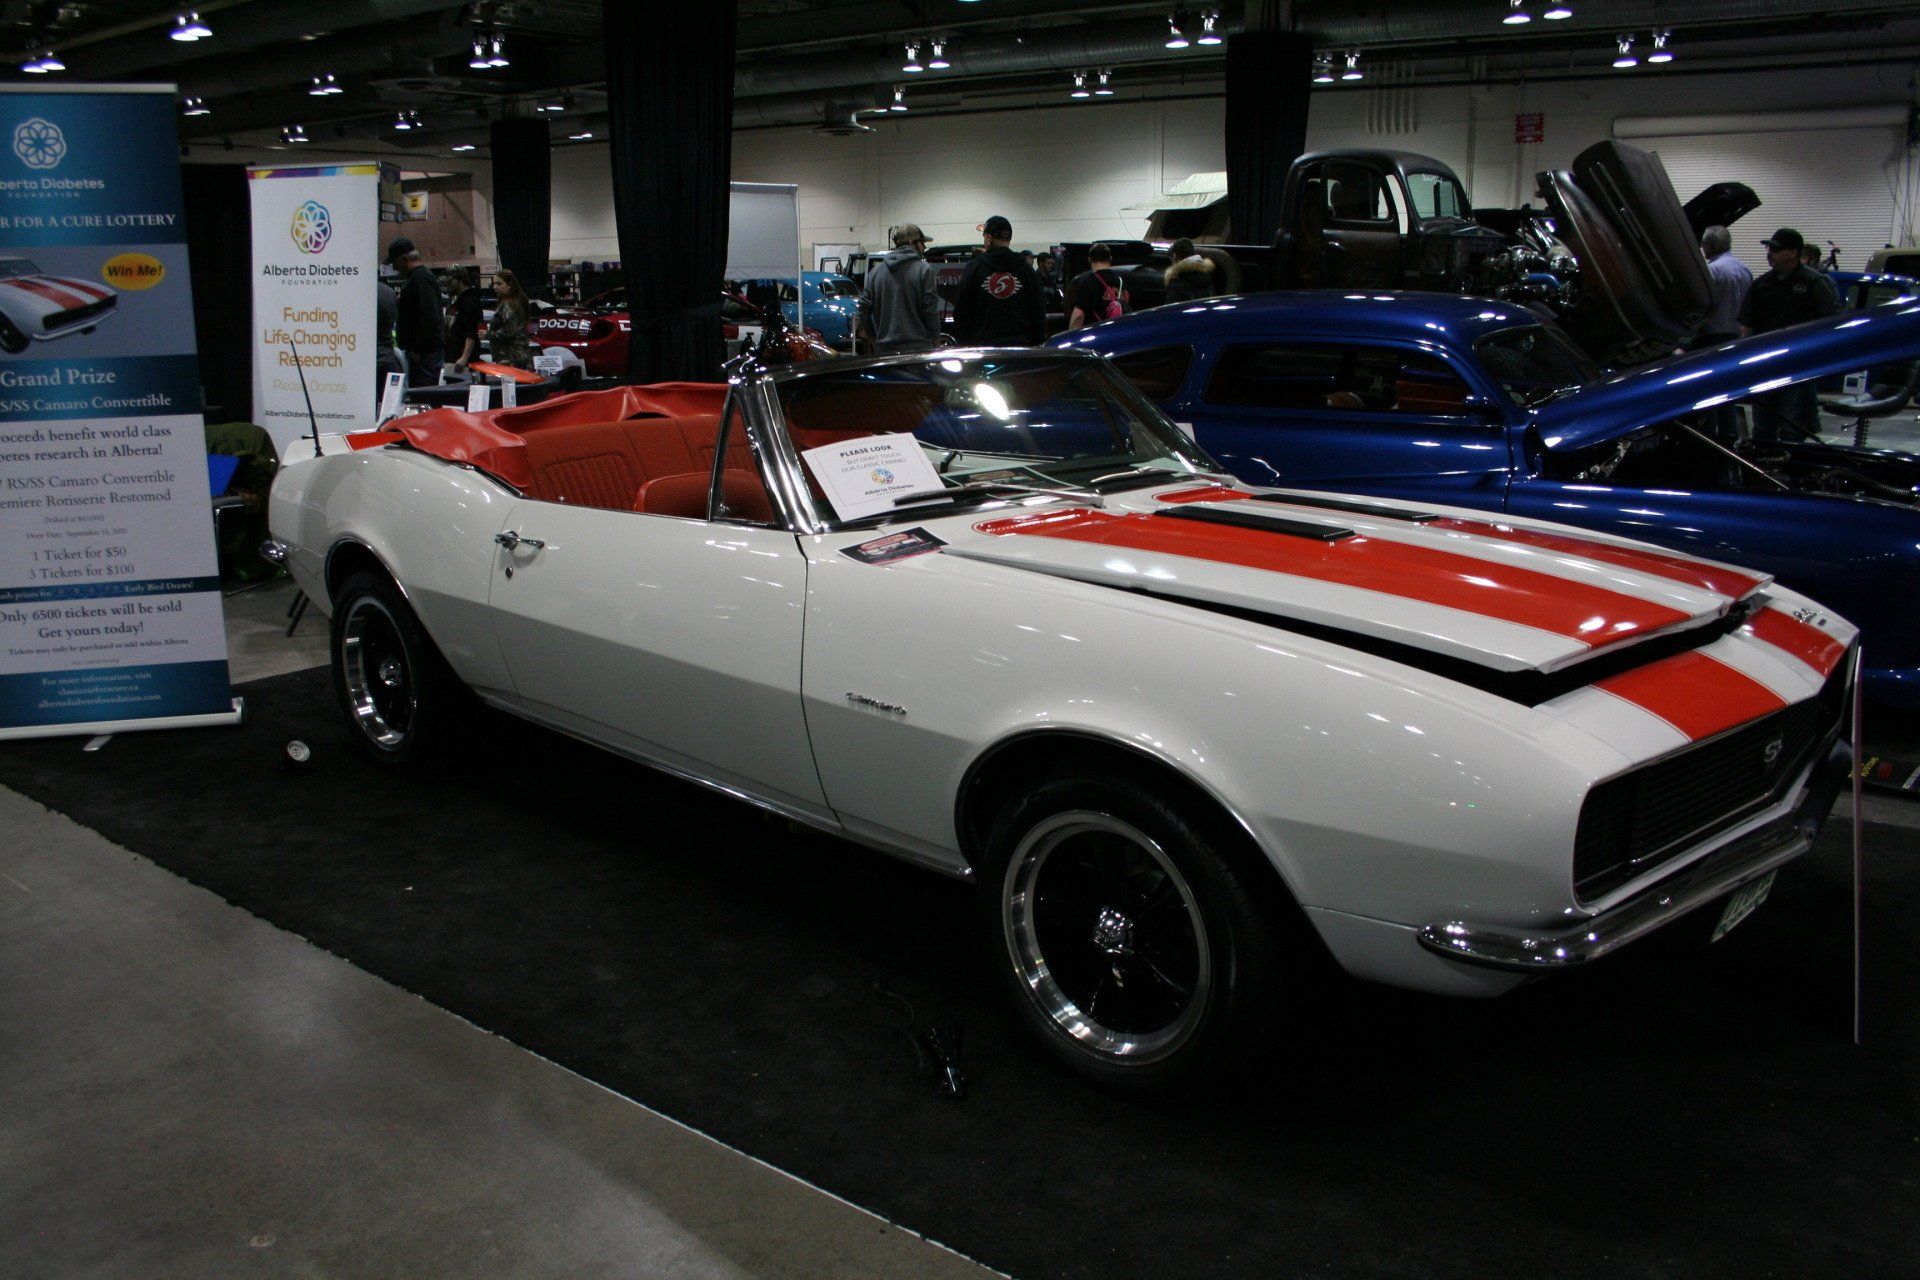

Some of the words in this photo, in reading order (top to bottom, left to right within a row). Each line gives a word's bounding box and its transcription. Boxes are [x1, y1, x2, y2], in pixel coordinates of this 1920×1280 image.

[42, 178, 105, 190] Diabetes
[14, 217, 45, 229] FOR
[49, 217, 59, 228] A
[63, 215, 103, 227] CURE
[106, 213, 176, 226] LOTTERY
[108, 265, 133, 277] Win
[137, 264, 162, 277] Me!
[263, 264, 307, 276] Alberta
[309, 264, 359, 276] Diabetes
[283, 307, 338, 328] Funding
[539, 318, 592, 331] DODGE
[264, 329, 291, 345] Life
[293, 329, 356, 351] Changing
[278, 352, 343, 368] Research
[0, 368, 61, 387] Grand
[68, 367, 117, 385] Prize
[34, 398, 88, 412] Camaro
[92, 393, 172, 409] Convertible
[0, 429, 46, 444] oceeds
[50, 426, 96, 442] benefit
[100, 426, 139, 439] world
[143, 425, 172, 438] class
[35, 446, 89, 461] research
[94, 447, 107, 458] in
[112, 443, 163, 458] Alberta!
[840, 448, 869, 458] PLEASE
[870, 444, 893, 453] LOOK
[8, 476, 45, 490] RS/SS
[49, 475, 99, 488] Camaro
[103, 470, 176, 486] Convertible
[0, 496, 42, 510] emiere
[47, 493, 106, 508] Rotisserie
[110, 489, 171, 504] Restomod
[33, 551, 39, 562] 1
[43, 548, 82, 562] Ticket
[85, 546, 102, 560] for
[106, 546, 127, 559] $50
[28, 569, 36, 580] 3
[39, 565, 83, 579] Tickets
[86, 564, 103, 577] for
[106, 562, 135, 576] $100
[148, 582, 164, 591] Bird
[33, 608, 62, 620] 6500
[65, 606, 108, 619] tickets
[110, 602, 135, 615] will
[139, 602, 154, 614] be
[157, 600, 183, 612] sold
[38, 627, 63, 639] Get
[65, 626, 101, 641] yours
[105, 621, 144, 637] today!
[164, 637, 189, 646] Alberta
